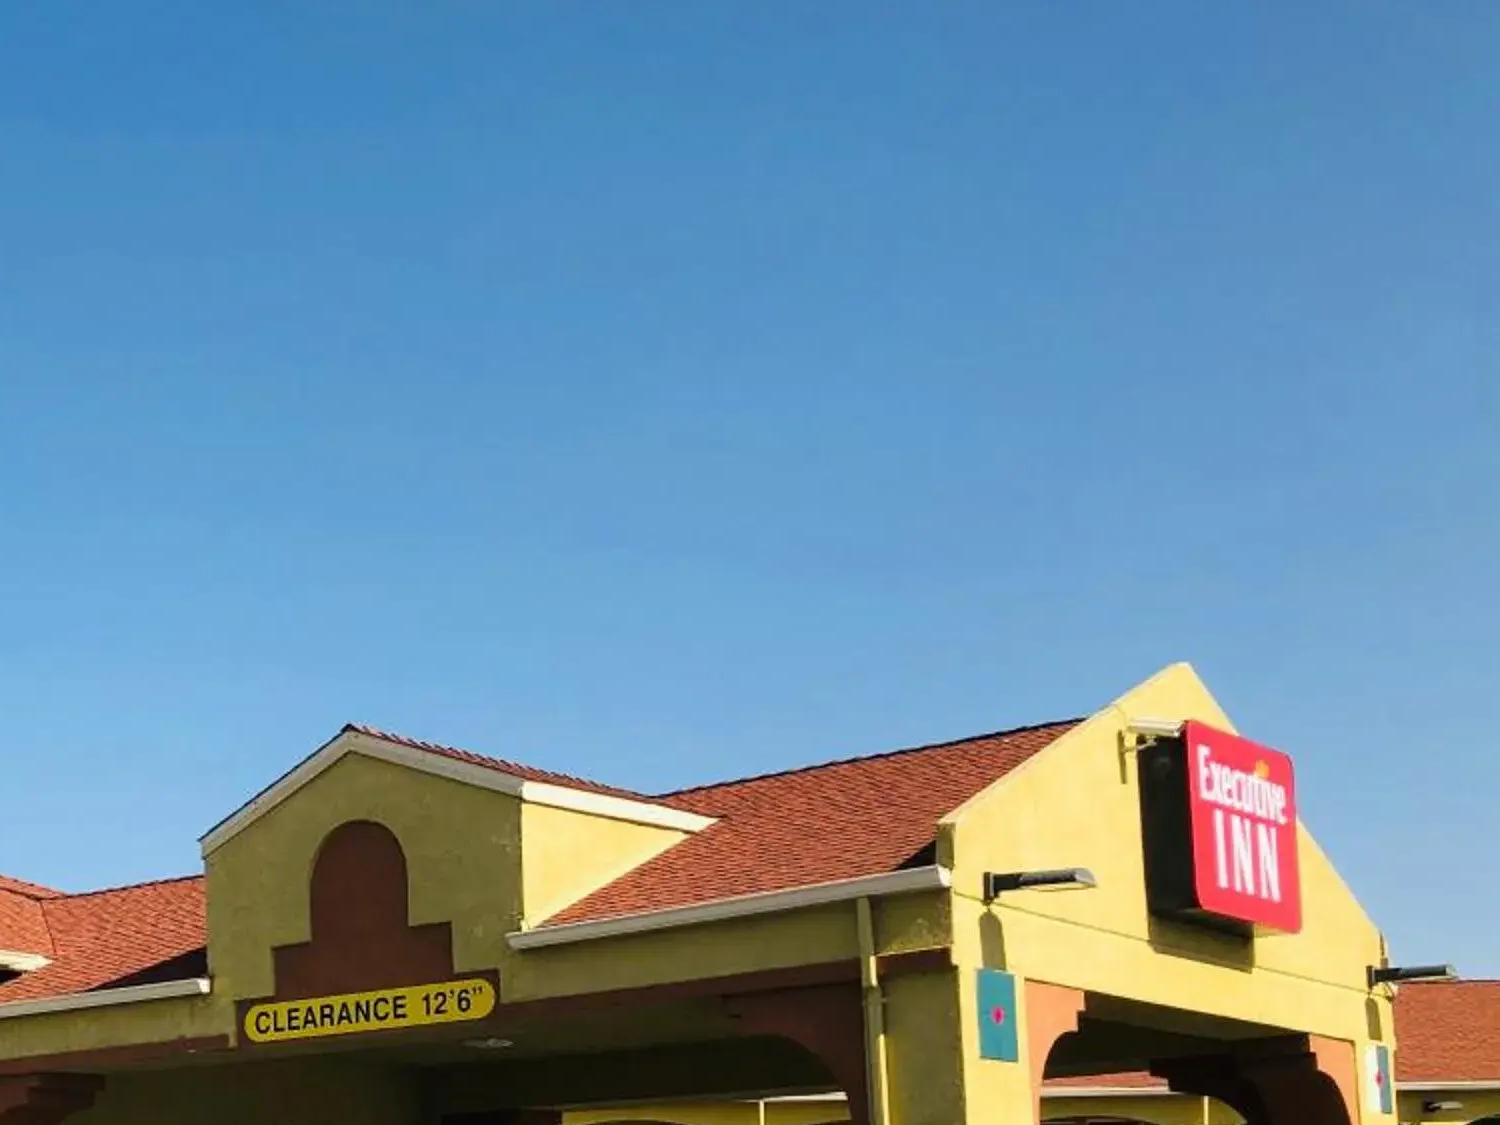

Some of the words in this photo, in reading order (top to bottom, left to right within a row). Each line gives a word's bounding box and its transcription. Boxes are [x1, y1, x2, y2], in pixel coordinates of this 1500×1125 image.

[1197, 745, 1287, 825] Executive
[1214, 809, 1281, 903] INN
[254, 996, 407, 1035] CLEARANCE
